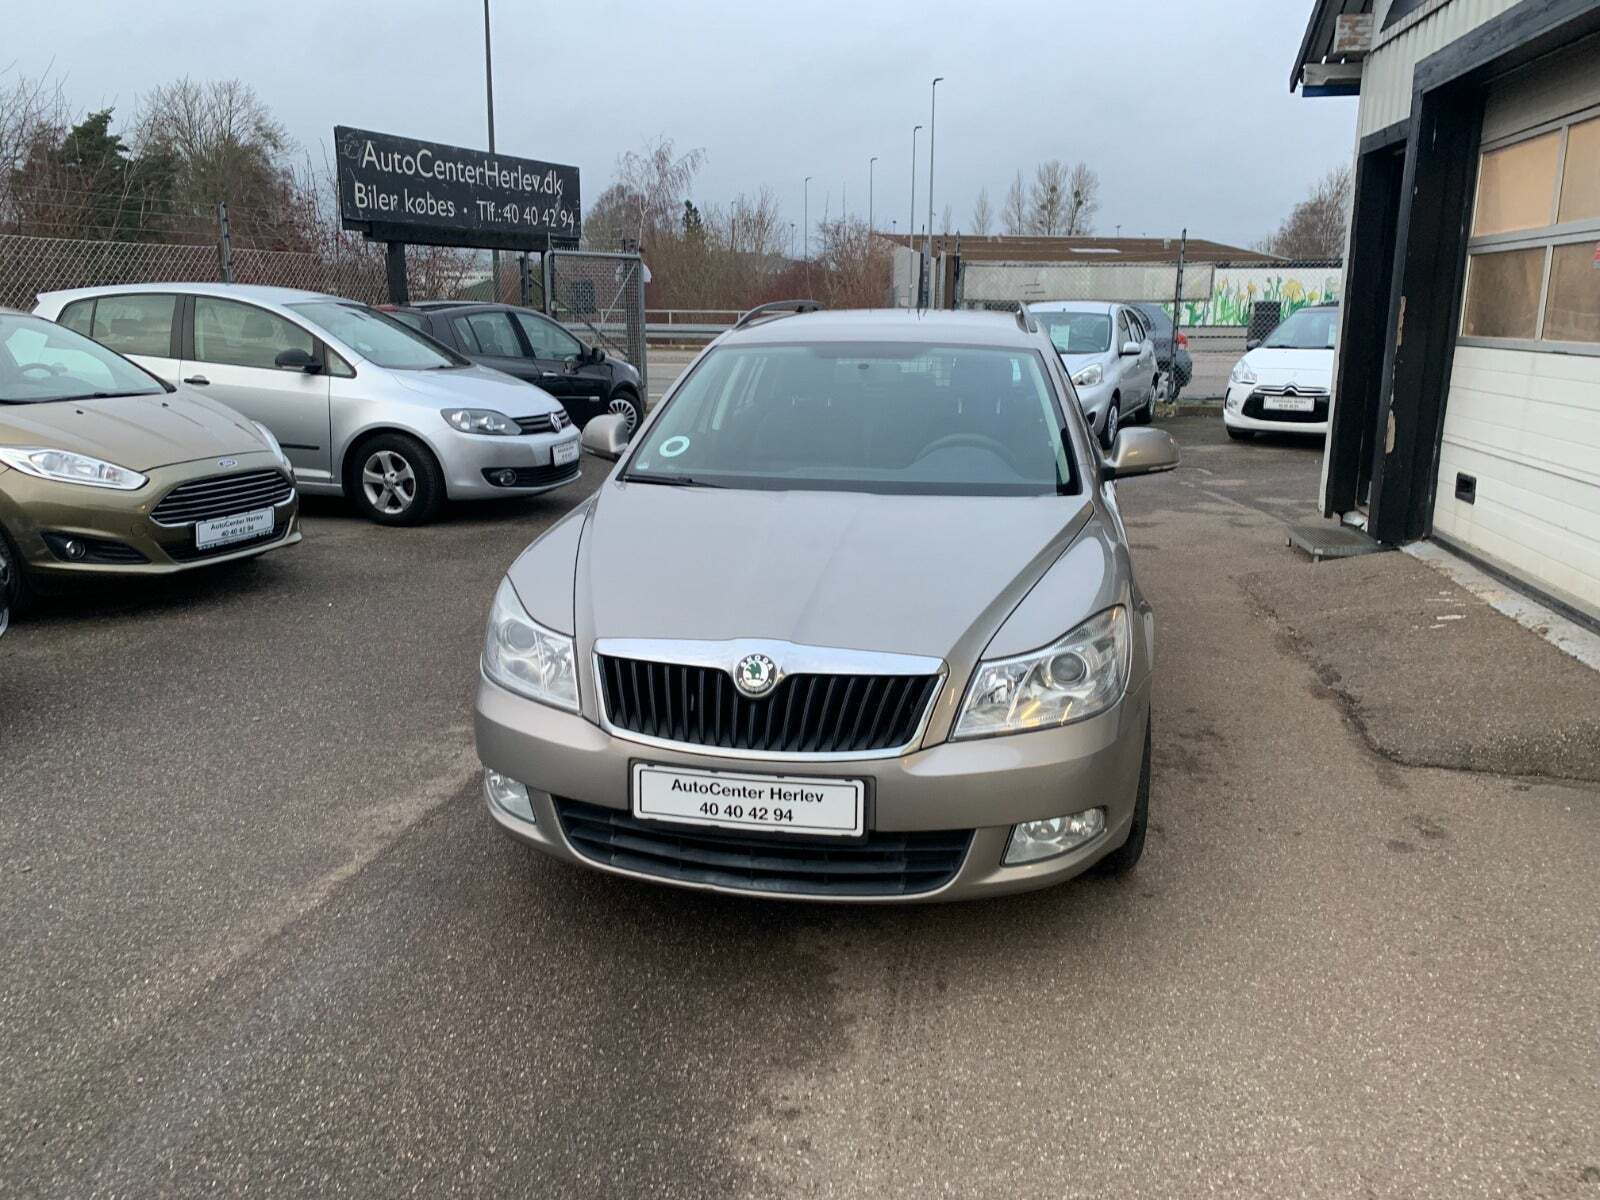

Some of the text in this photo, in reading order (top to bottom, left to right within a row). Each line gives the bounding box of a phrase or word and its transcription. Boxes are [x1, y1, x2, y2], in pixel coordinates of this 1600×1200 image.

[361, 140, 563, 197] AutoCenterHerlev.dk
[354, 182, 398, 211] Biler
[405, 188, 455, 218] købes
[523, 206, 538, 226] 40
[542, 208, 557, 228] 42
[560, 209, 575, 232] 94
[671, 778, 824, 803] AutoCenter Herlev
[699, 802, 793, 822] 40 40 42 94
